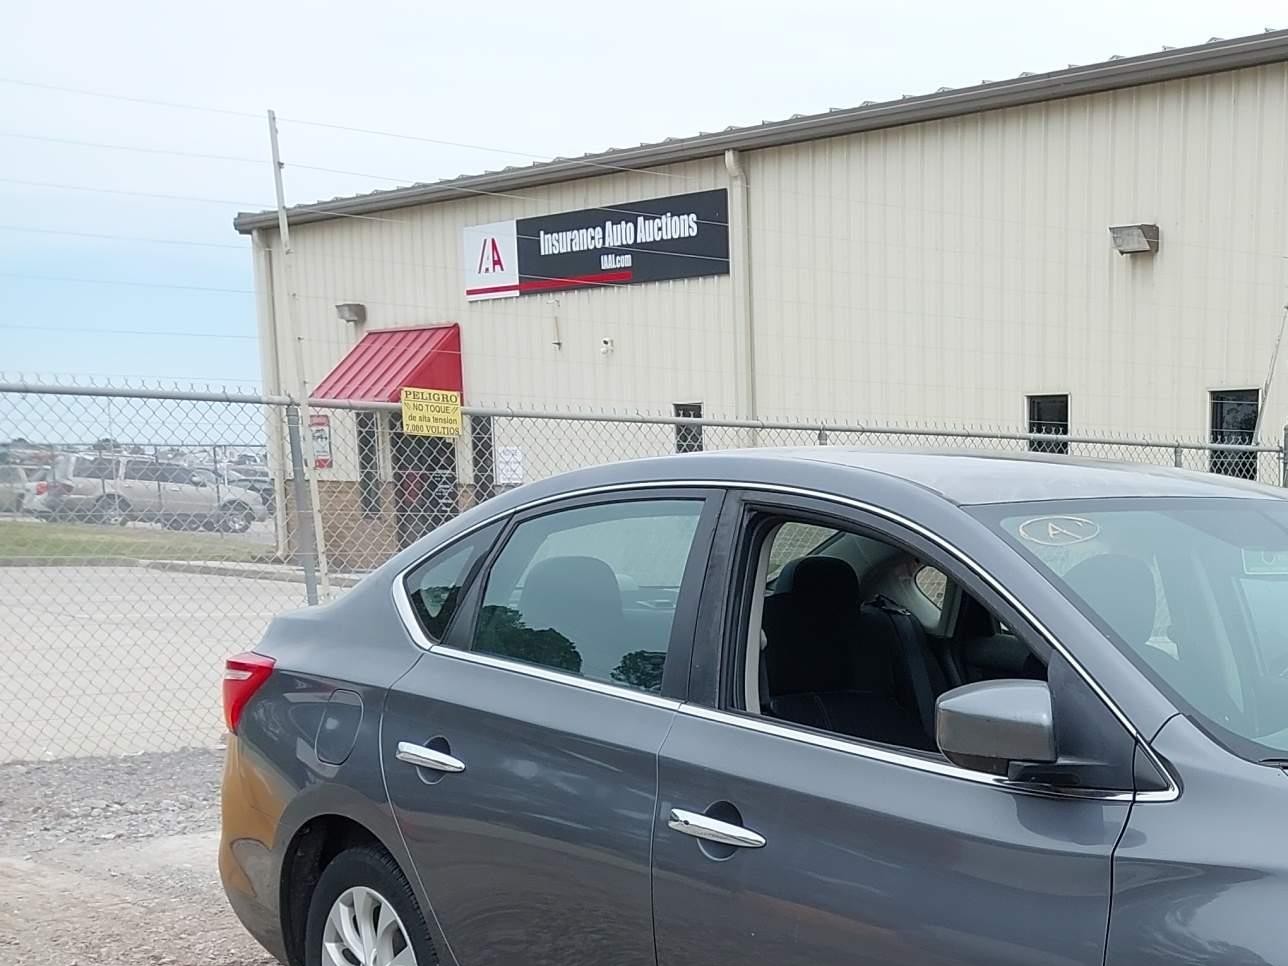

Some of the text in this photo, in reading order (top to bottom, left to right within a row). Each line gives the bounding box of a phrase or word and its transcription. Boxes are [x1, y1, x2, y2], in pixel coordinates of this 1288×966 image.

[539, 212, 698, 256] Insurance Auto Auctions
[404, 390, 458, 403] PELIGRO
[412, 402, 451, 414] NO TOQUE
[408, 413, 417, 422] de
[425, 424, 460, 436] VOLTIOS
